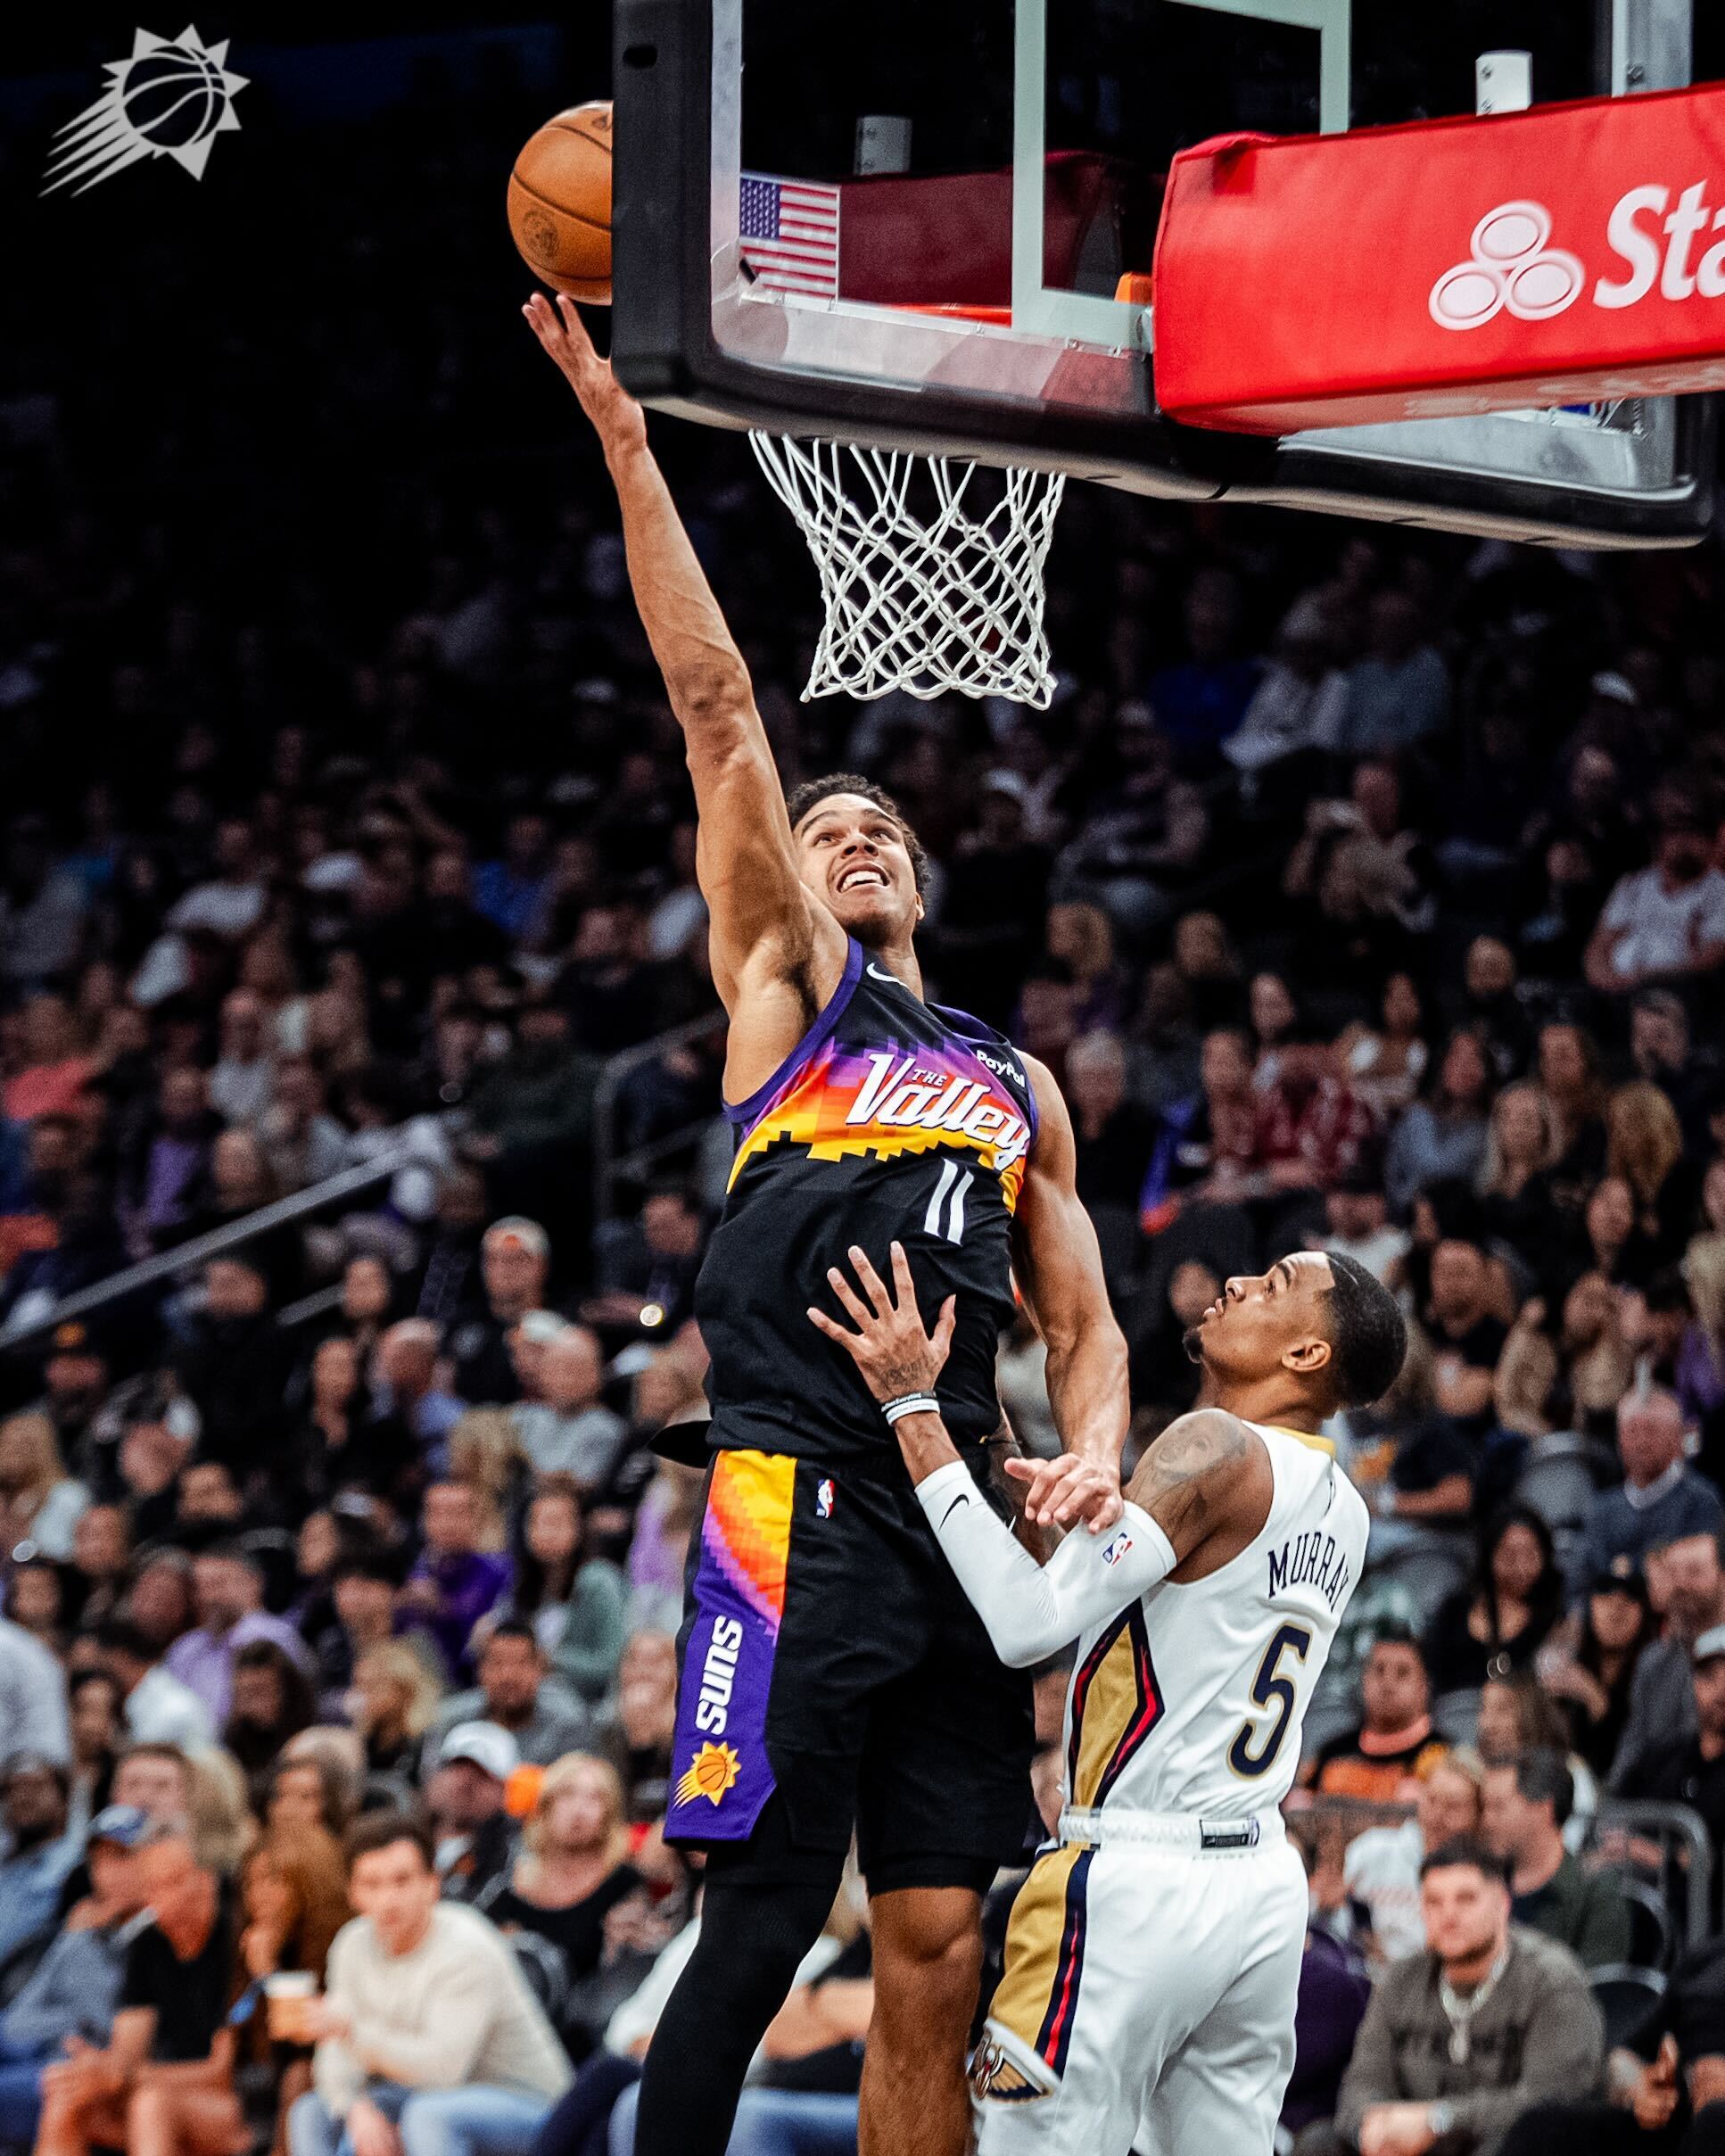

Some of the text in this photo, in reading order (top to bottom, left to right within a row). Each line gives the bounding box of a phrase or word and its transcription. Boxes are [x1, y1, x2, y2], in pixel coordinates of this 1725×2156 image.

[912, 1070, 947, 1086] THE
[977, 1050, 1026, 1087] PayPal
[846, 1053, 1030, 1170] Valley
[924, 1159, 974, 1245] 11
[1267, 1532, 1349, 1613] MURRAY
[1226, 1621, 1313, 1782] 5
